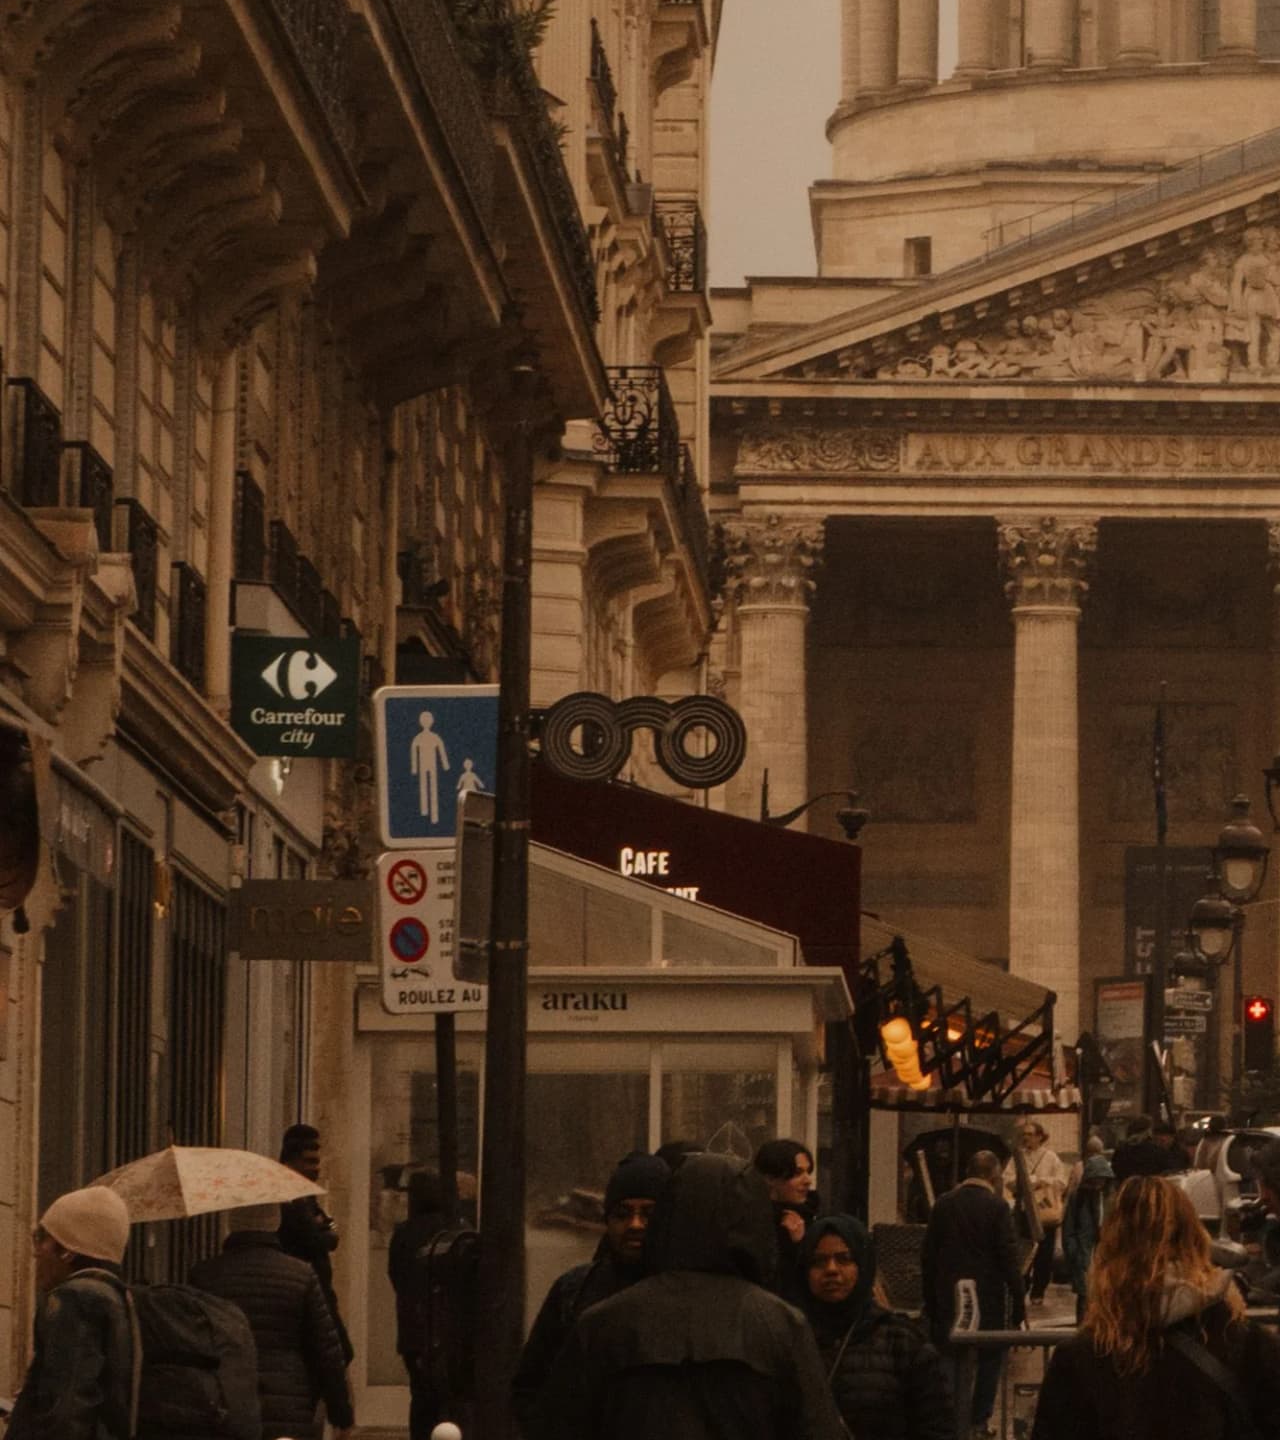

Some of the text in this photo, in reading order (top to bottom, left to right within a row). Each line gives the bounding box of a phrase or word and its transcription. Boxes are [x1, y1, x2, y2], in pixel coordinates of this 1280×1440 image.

[916, 436, 1005, 469] AUX
[1016, 436, 1187, 469] GRANDS
[250, 707, 347, 726] Carrefour
[279, 728, 316, 750] city
[398, 989, 482, 1007] ROULEZ AU
[541, 990, 629, 1011] araku
